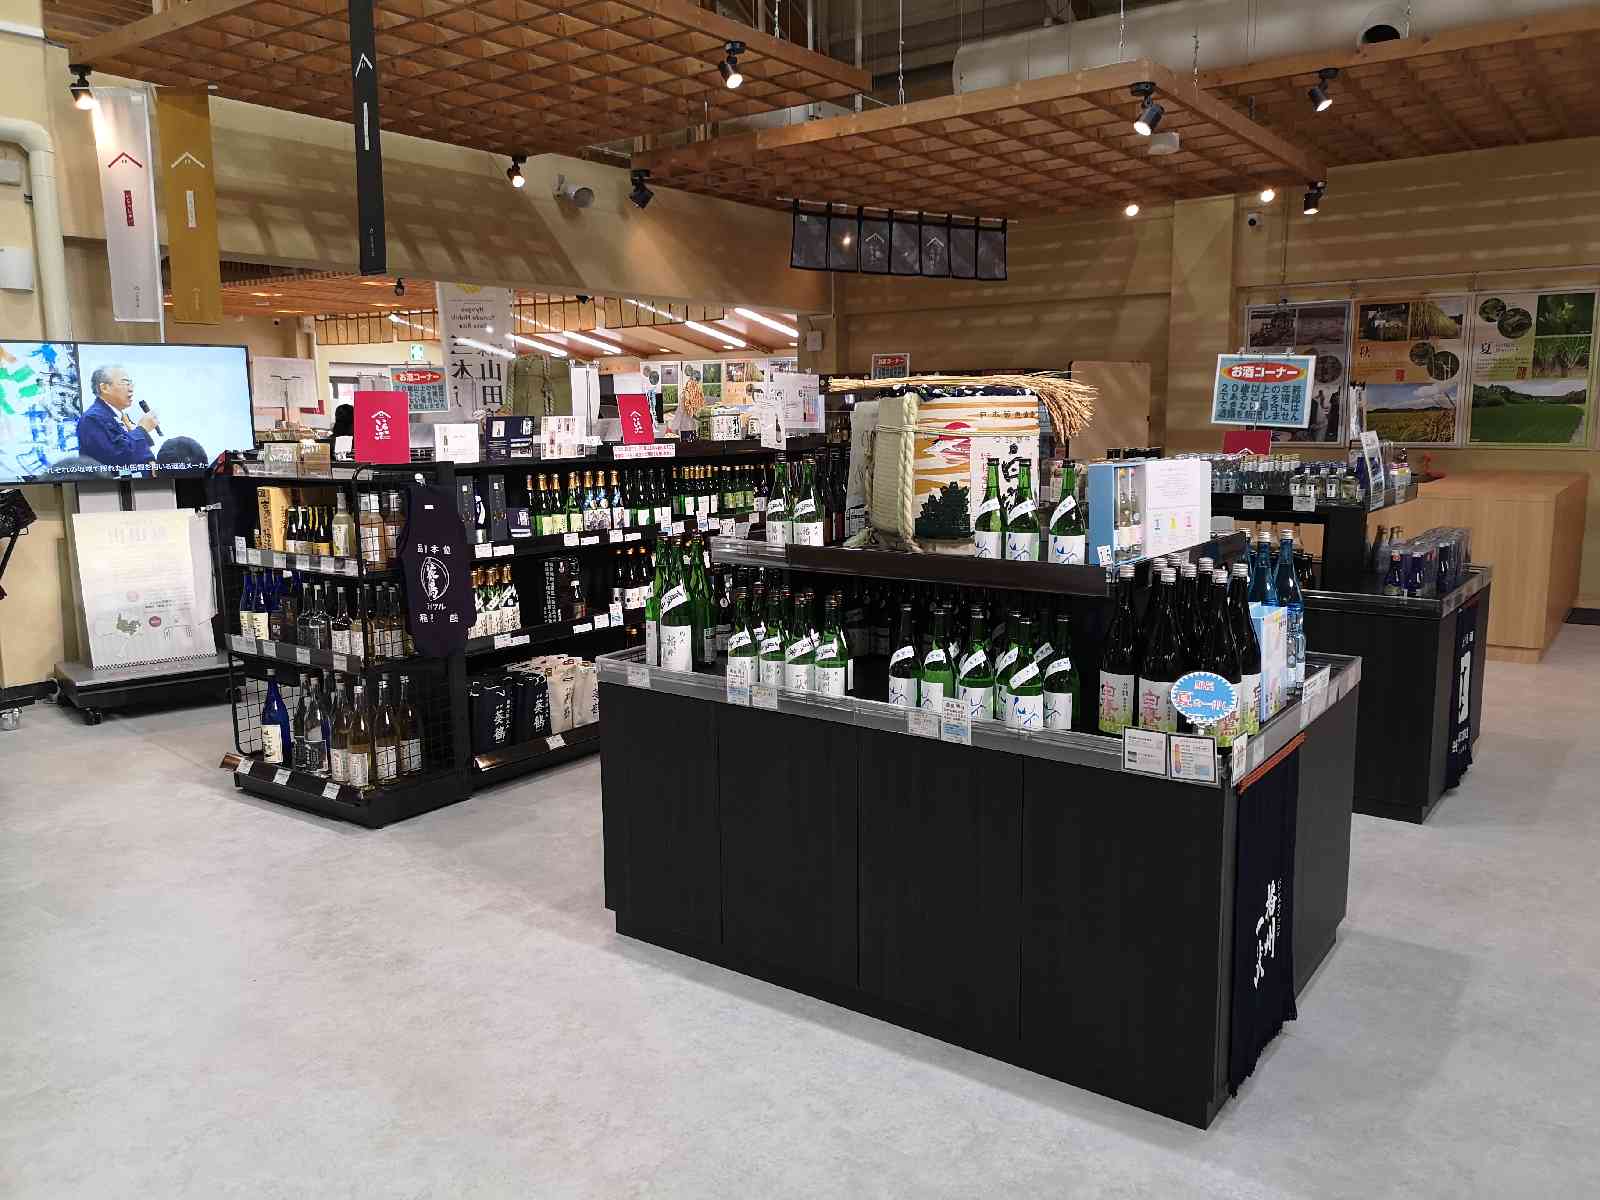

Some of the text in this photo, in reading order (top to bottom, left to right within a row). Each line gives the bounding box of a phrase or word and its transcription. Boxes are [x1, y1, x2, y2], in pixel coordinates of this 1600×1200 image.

[400, 373, 440, 382] お酒コーナー
[1231, 366, 1298, 379] お酒コーナー
